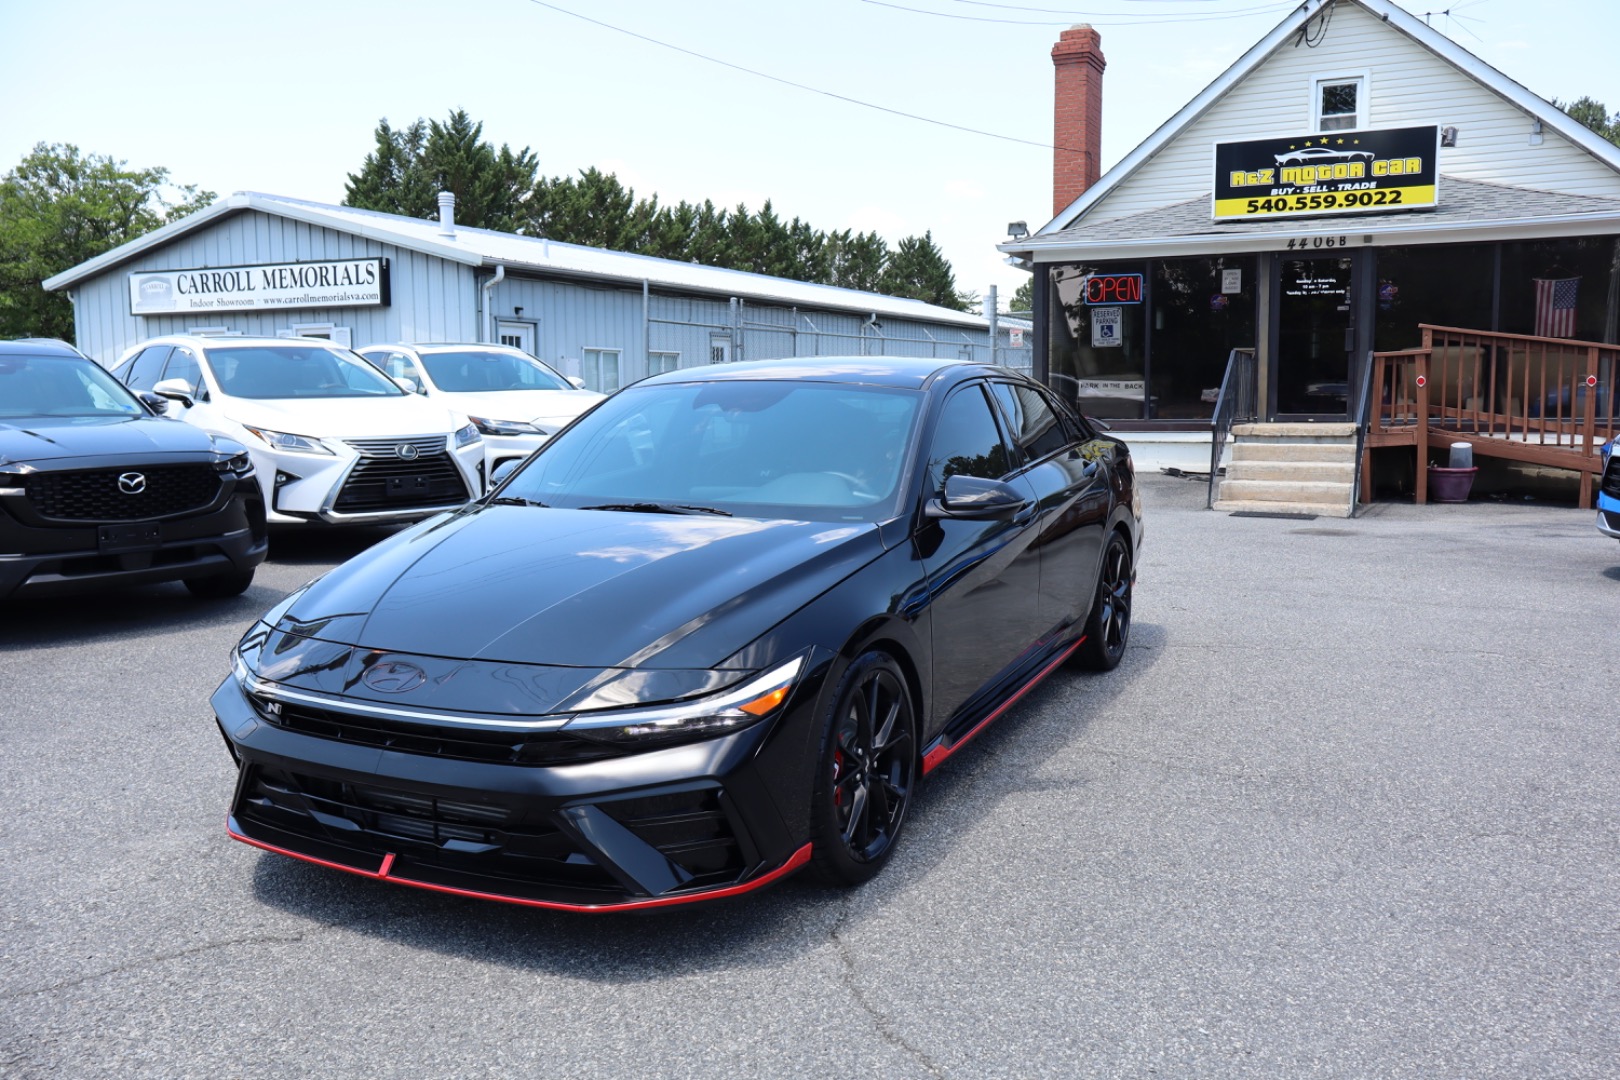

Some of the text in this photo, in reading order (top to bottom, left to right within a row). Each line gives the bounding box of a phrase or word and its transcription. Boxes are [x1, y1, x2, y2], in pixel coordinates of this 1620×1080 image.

[1270, 181, 1378, 196] BUY SELL TRADE
[1246, 190, 1403, 214] 540.559.9022
[177, 262, 376, 295] CARROLL MEMORIALS
[1087, 276, 1141, 302] OPEN
[190, 291, 379, 308] Indoor Showroom www.carrollmemorialsva.com
